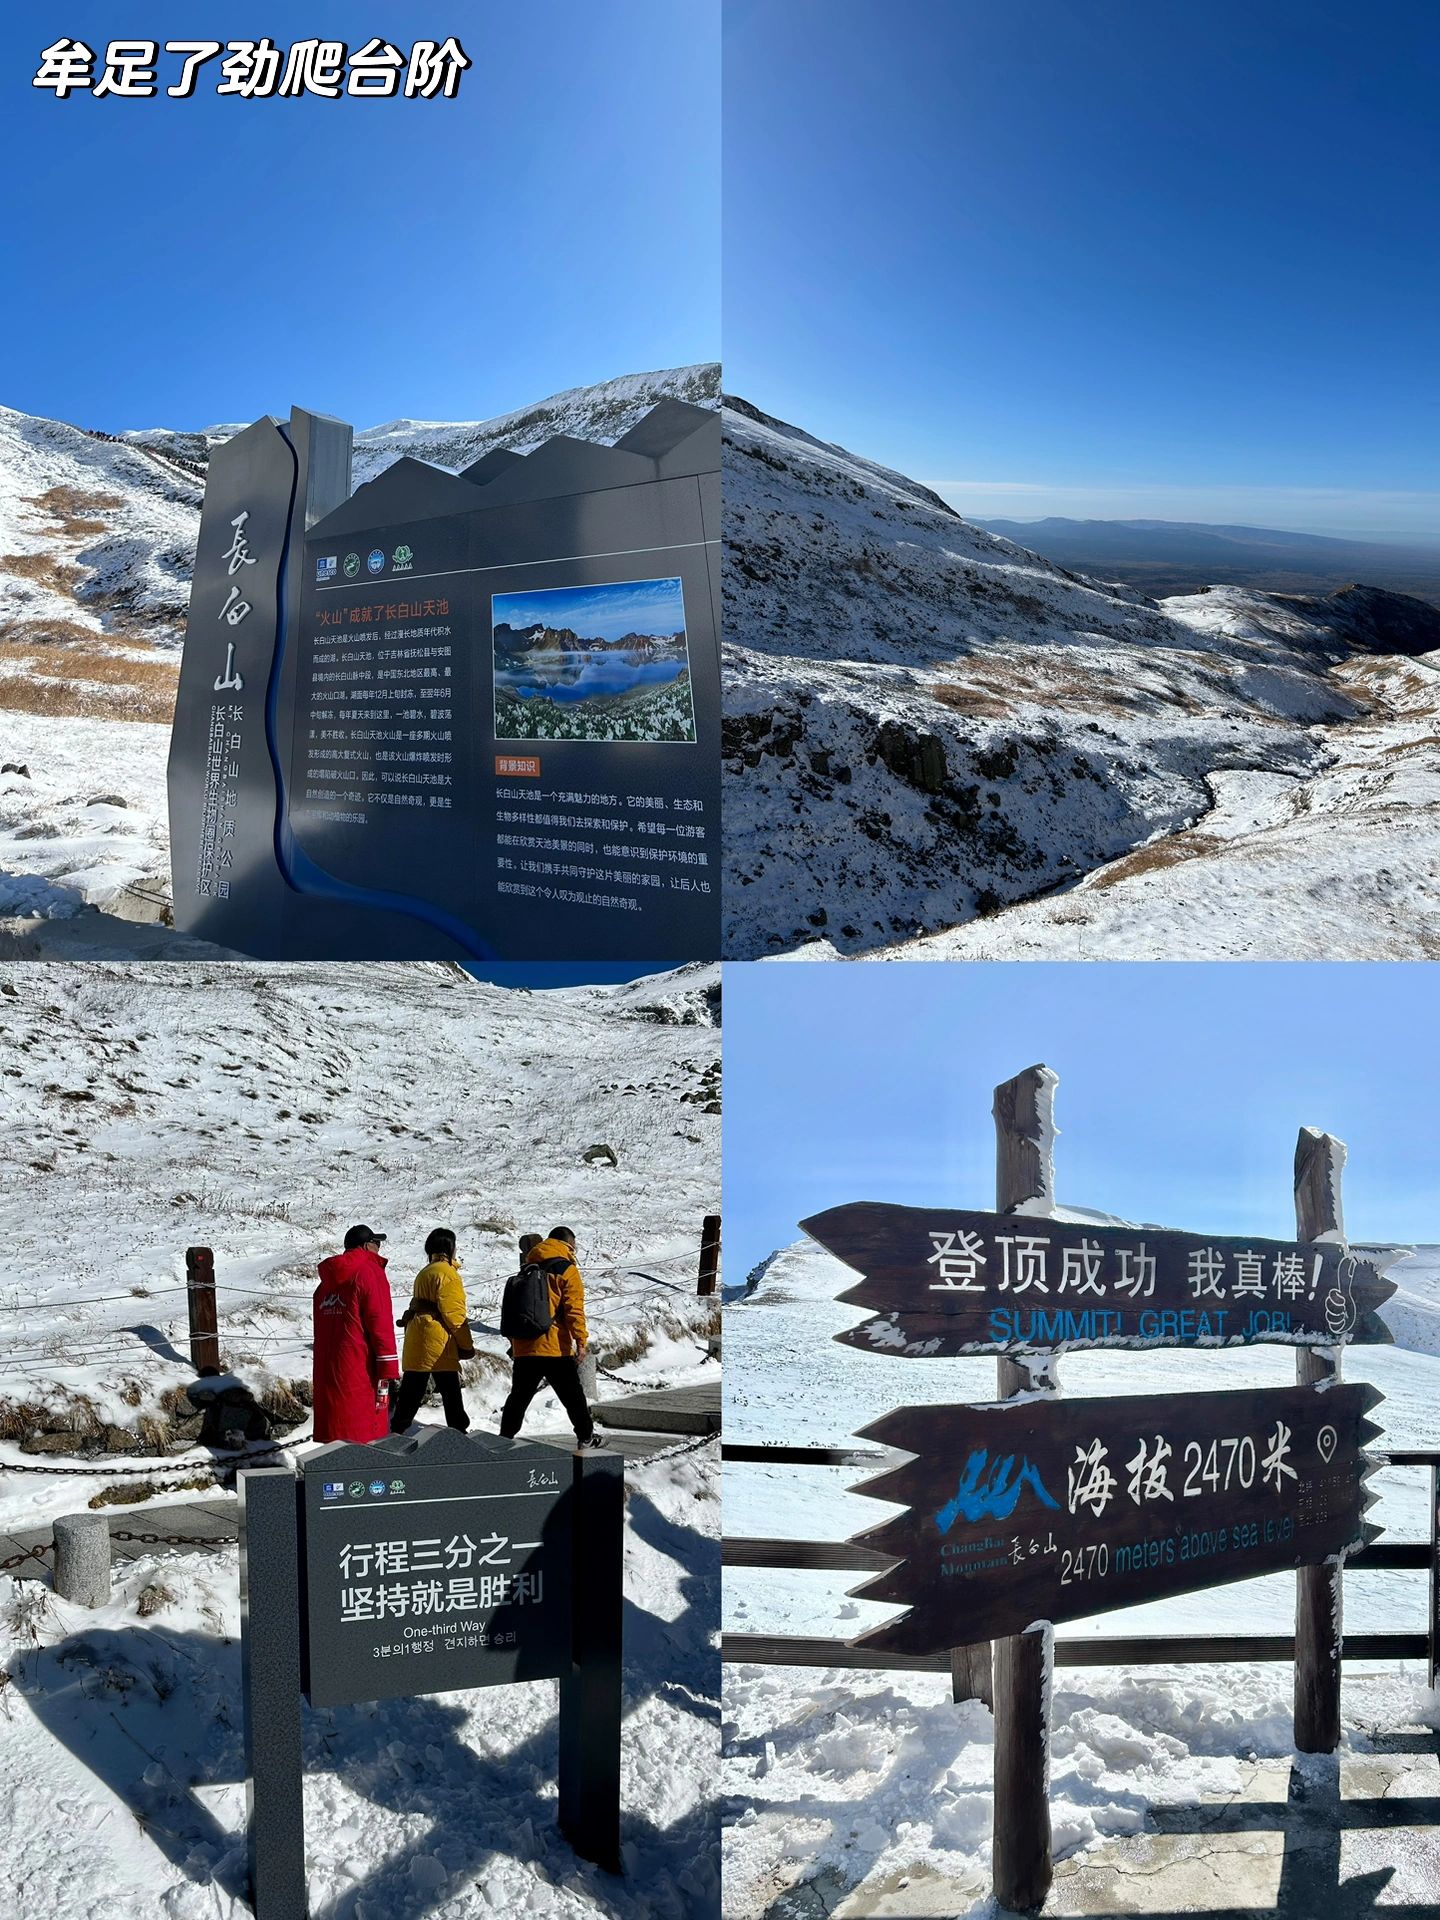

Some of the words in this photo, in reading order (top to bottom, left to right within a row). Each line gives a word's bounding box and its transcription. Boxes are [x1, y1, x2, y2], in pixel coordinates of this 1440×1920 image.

[315, 599, 449, 626] “火山”成就了长白山天池
[499, 760, 536, 772] 背景知识
[200, 705, 225, 895] 长白山世界生物圈保护区
[218, 705, 243, 899] 长白山地质公园
[496, 788, 704, 812] 长白山天池是一个充满魅力的地方。它的美丽、生态和
[496, 811, 706, 839] 生物多样性都值得我们去探索和保护。希望每一位游客
[497, 834, 708, 865] 都能在欣赏天池美景的同时，也能意识到保护环境的重
[927, 1229, 1157, 1297] 登顶成功
[987, 1306, 1121, 1343] SUMMIT!
[1139, 1309, 1228, 1339] GREAT
[1067, 1420, 1298, 1518] 海拔2470米
[338, 1532, 544, 1579] 行程三分之一
[1060, 1543, 1109, 1586] 2470
[1115, 1540, 1175, 1574] meters
[1180, 1527, 1228, 1560] above
[1231, 1522, 1258, 1550] sea
[340, 1570, 543, 1622] 坚持就是胜利
[373, 1640, 435, 1658] 3분의1행정
[444, 1635, 490, 1650] 견지하면
[403, 1622, 457, 1638] One-third
[460, 1620, 486, 1634] Way
